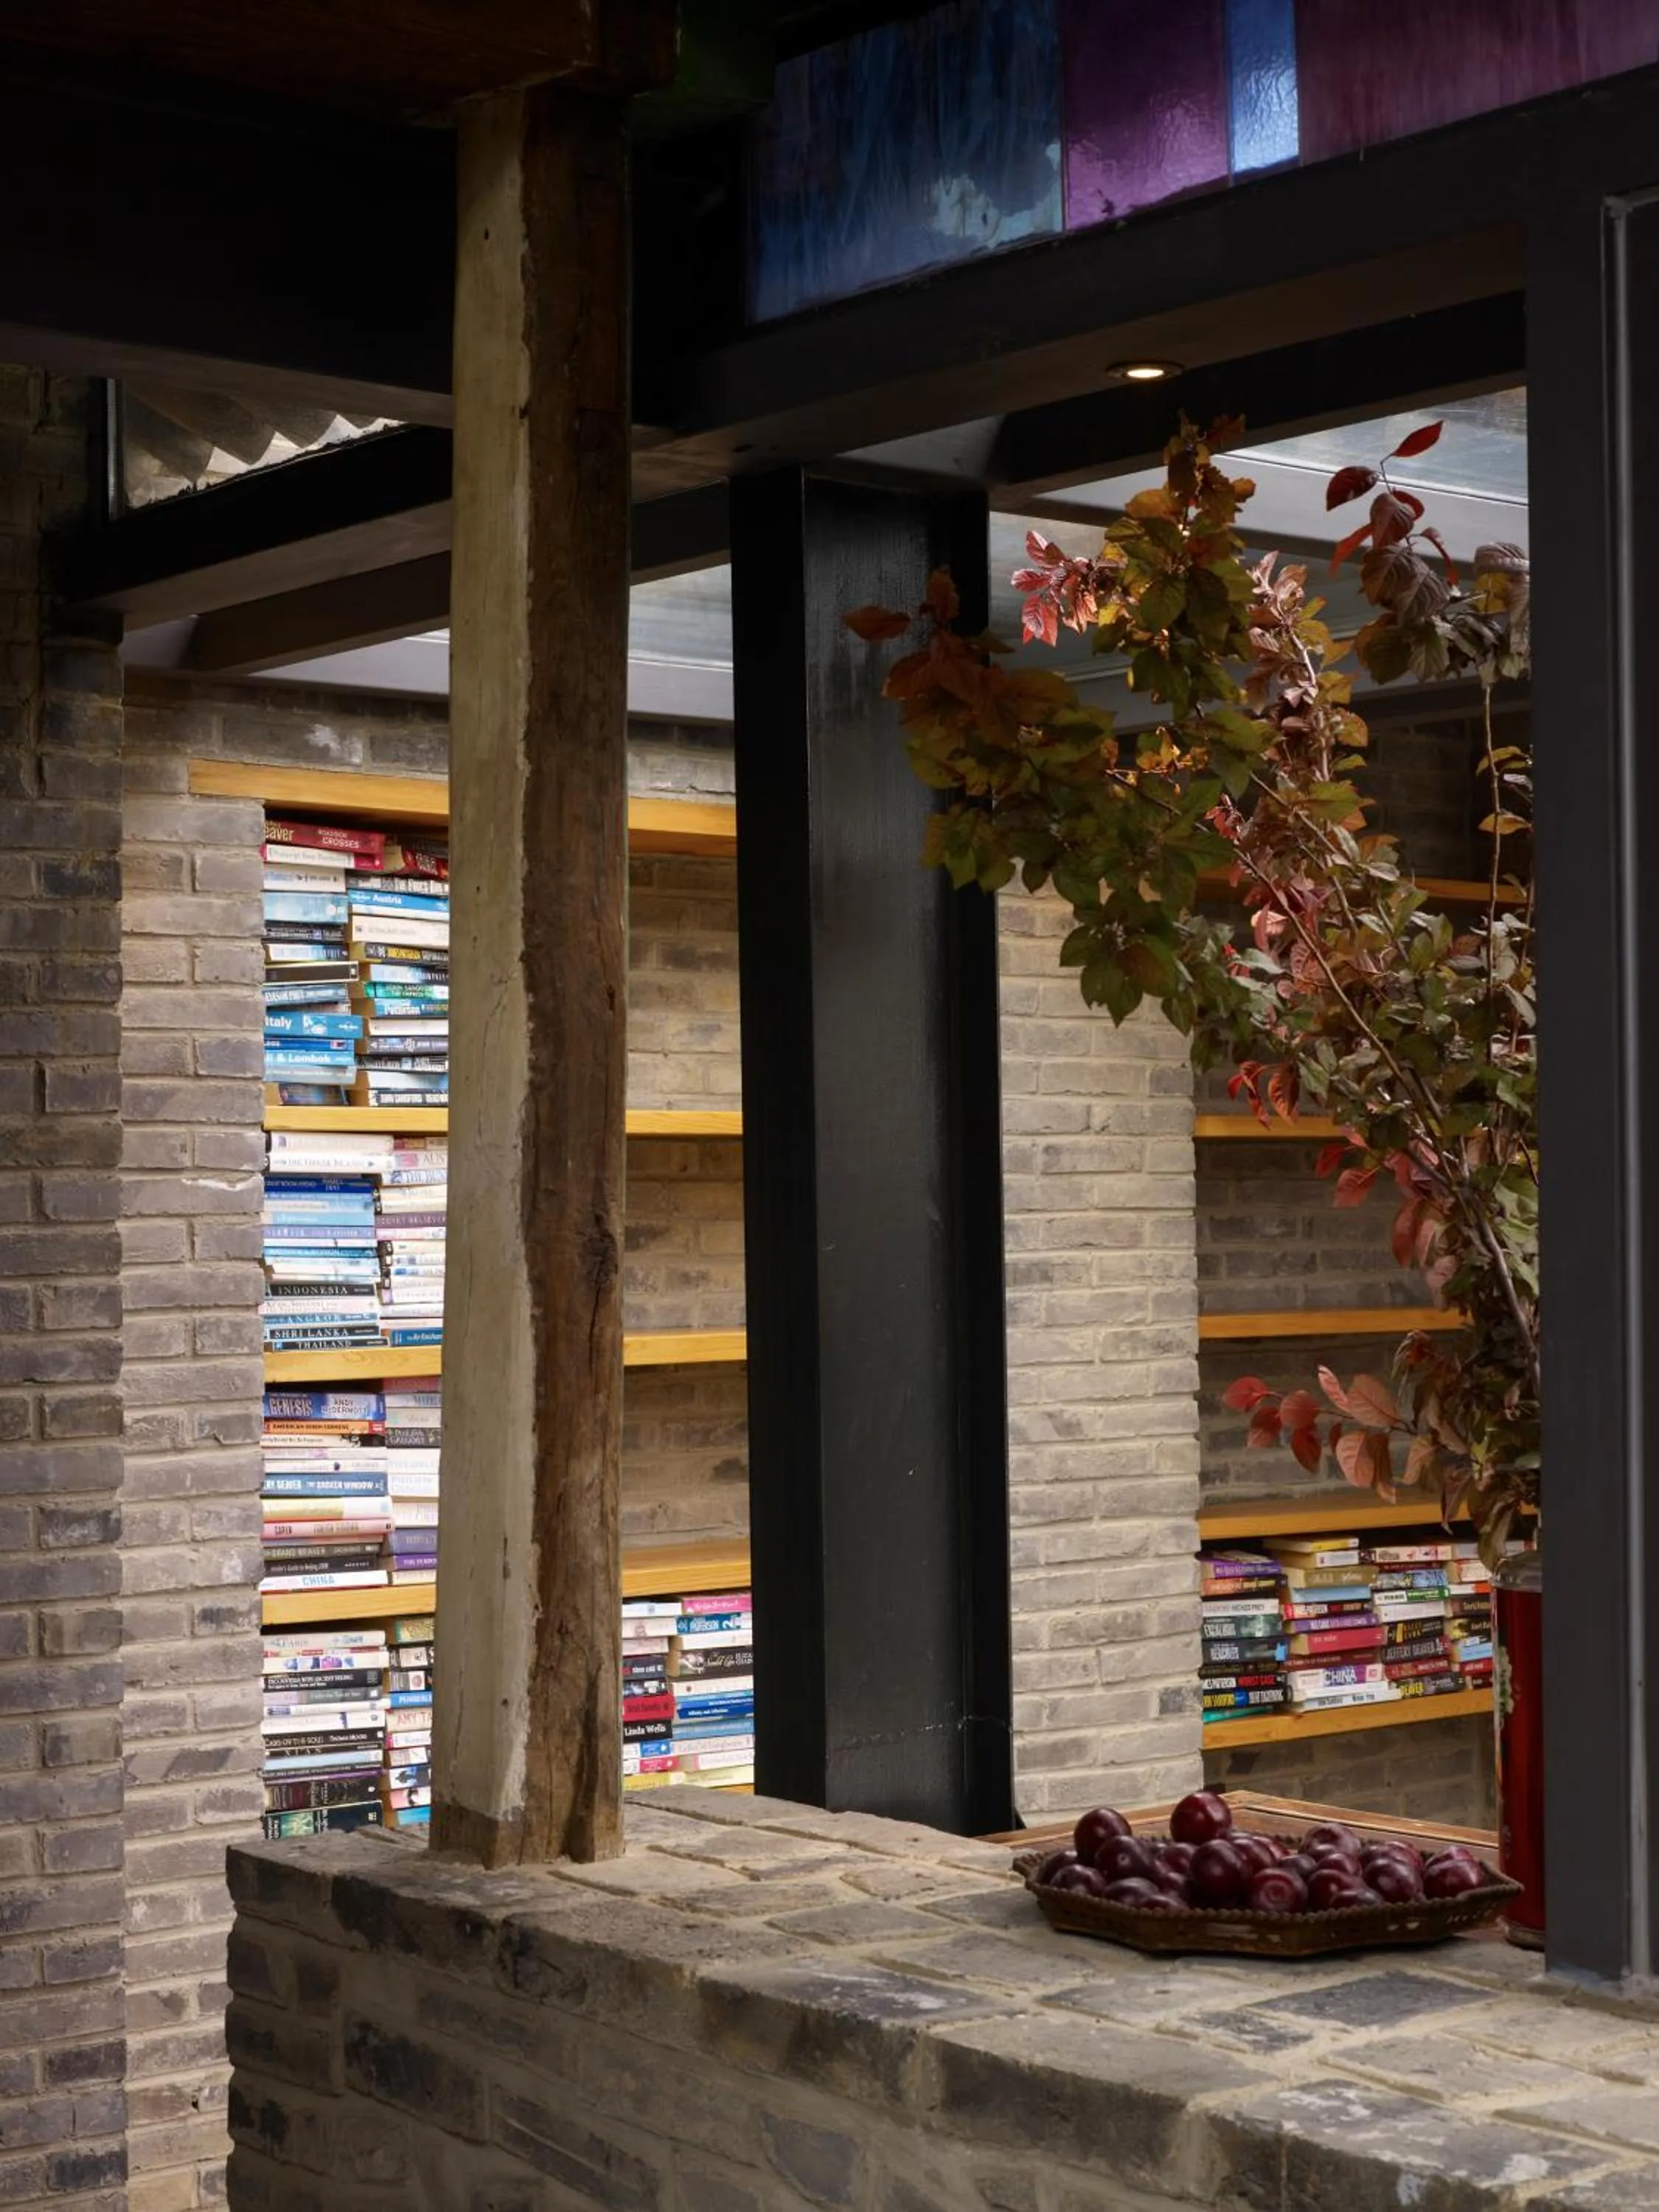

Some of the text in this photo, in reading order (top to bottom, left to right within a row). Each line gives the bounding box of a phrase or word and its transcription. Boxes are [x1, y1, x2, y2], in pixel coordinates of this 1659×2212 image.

[321, 837, 359, 849] CROSSES
[372, 893, 402, 905] Austria
[265, 1015, 291, 1030] Italy
[276, 1053, 287, 1062] &
[288, 1053, 331, 1062] Lombok
[278, 1285, 348, 1295] INDONESIA
[274, 1328, 349, 1339] SHRI LANKA
[298, 1340, 352, 1349] THAILAND
[302, 1575, 335, 1587] CHINA
[1324, 1667, 1357, 1686] CHINA
[625, 1725, 645, 1736] Linda
